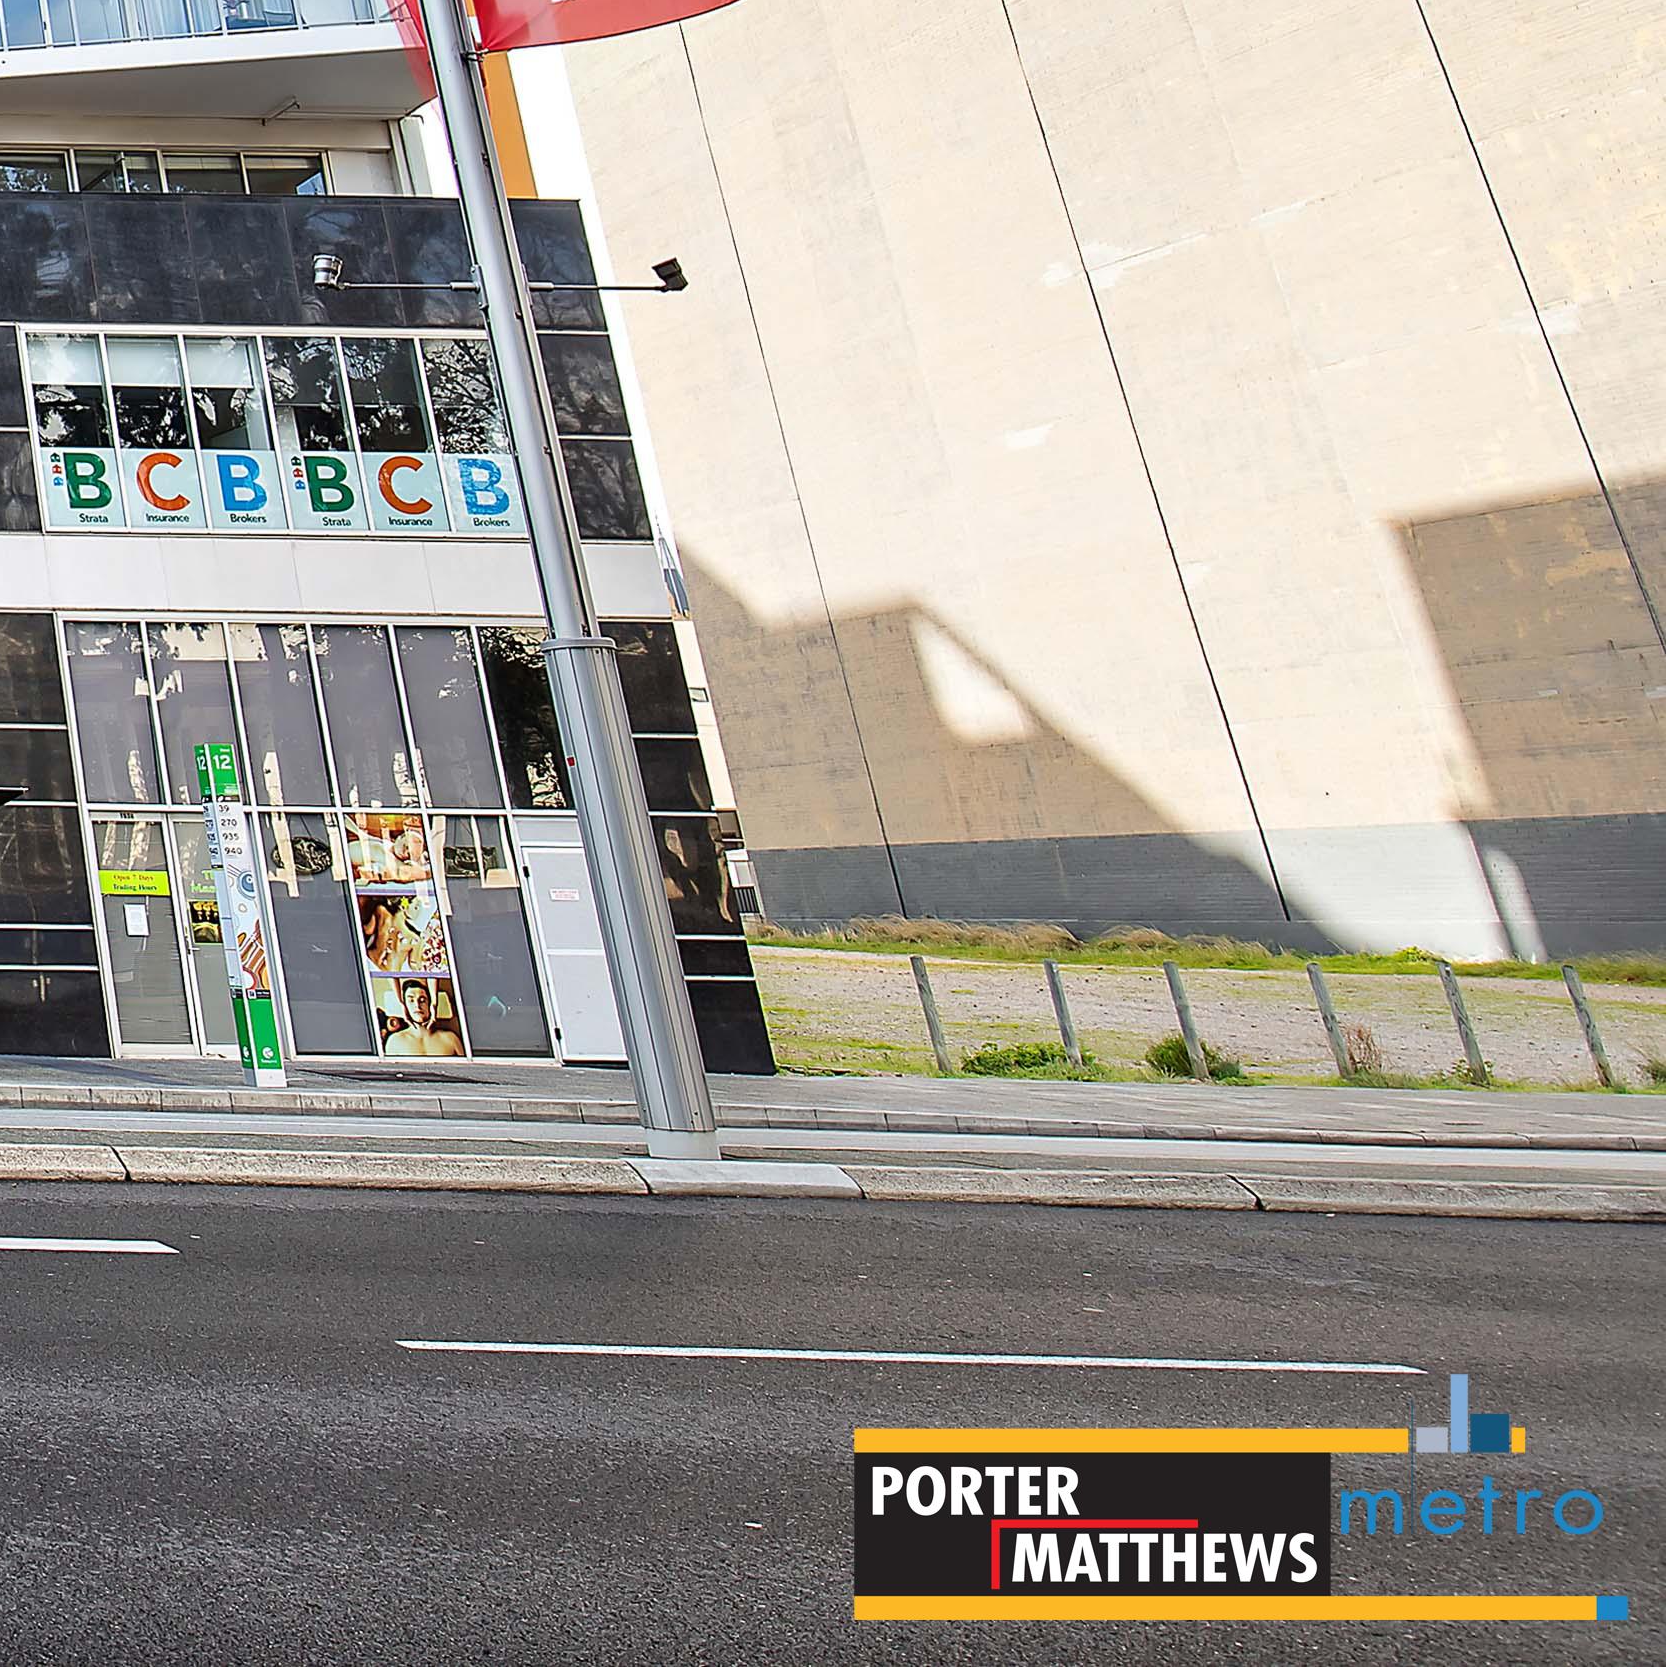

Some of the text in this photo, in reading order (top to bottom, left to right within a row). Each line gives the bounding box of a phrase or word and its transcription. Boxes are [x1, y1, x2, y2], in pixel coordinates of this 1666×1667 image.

[79, 513, 267, 524] Strata Insurance Brokers
[322, 516, 511, 527] Strata Insurance Brokers
[212, 754, 233, 770] 12
[218, 804, 230, 813] 39
[220, 818, 238, 827] 270
[222, 832, 240, 841] 935
[224, 846, 243, 855] 940
